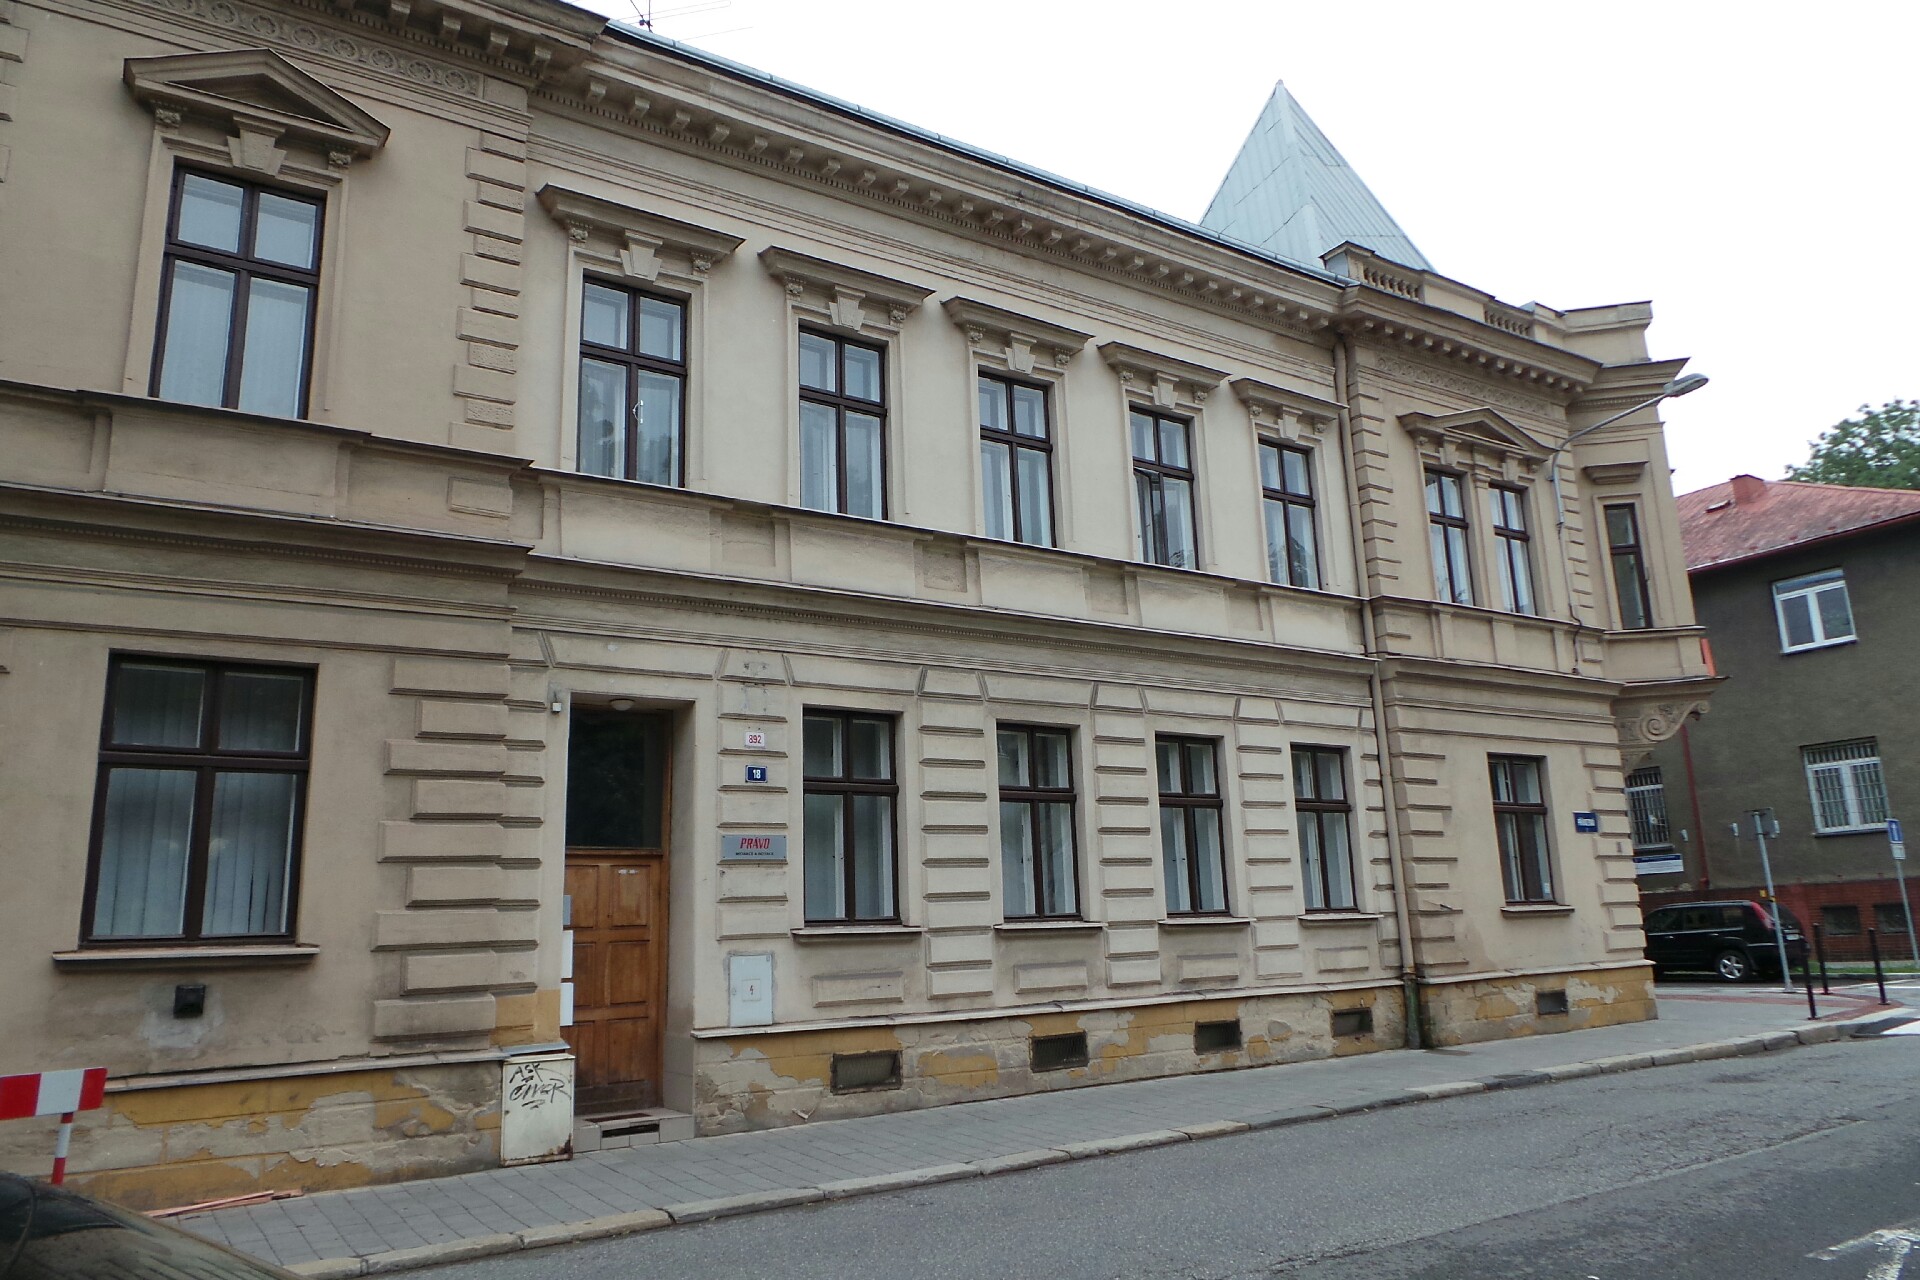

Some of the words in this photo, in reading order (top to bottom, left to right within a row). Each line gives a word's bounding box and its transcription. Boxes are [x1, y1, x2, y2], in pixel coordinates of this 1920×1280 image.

[748, 734, 762, 744] 892
[752, 769, 761, 779] 18
[740, 836, 770, 849] PRÁVO
